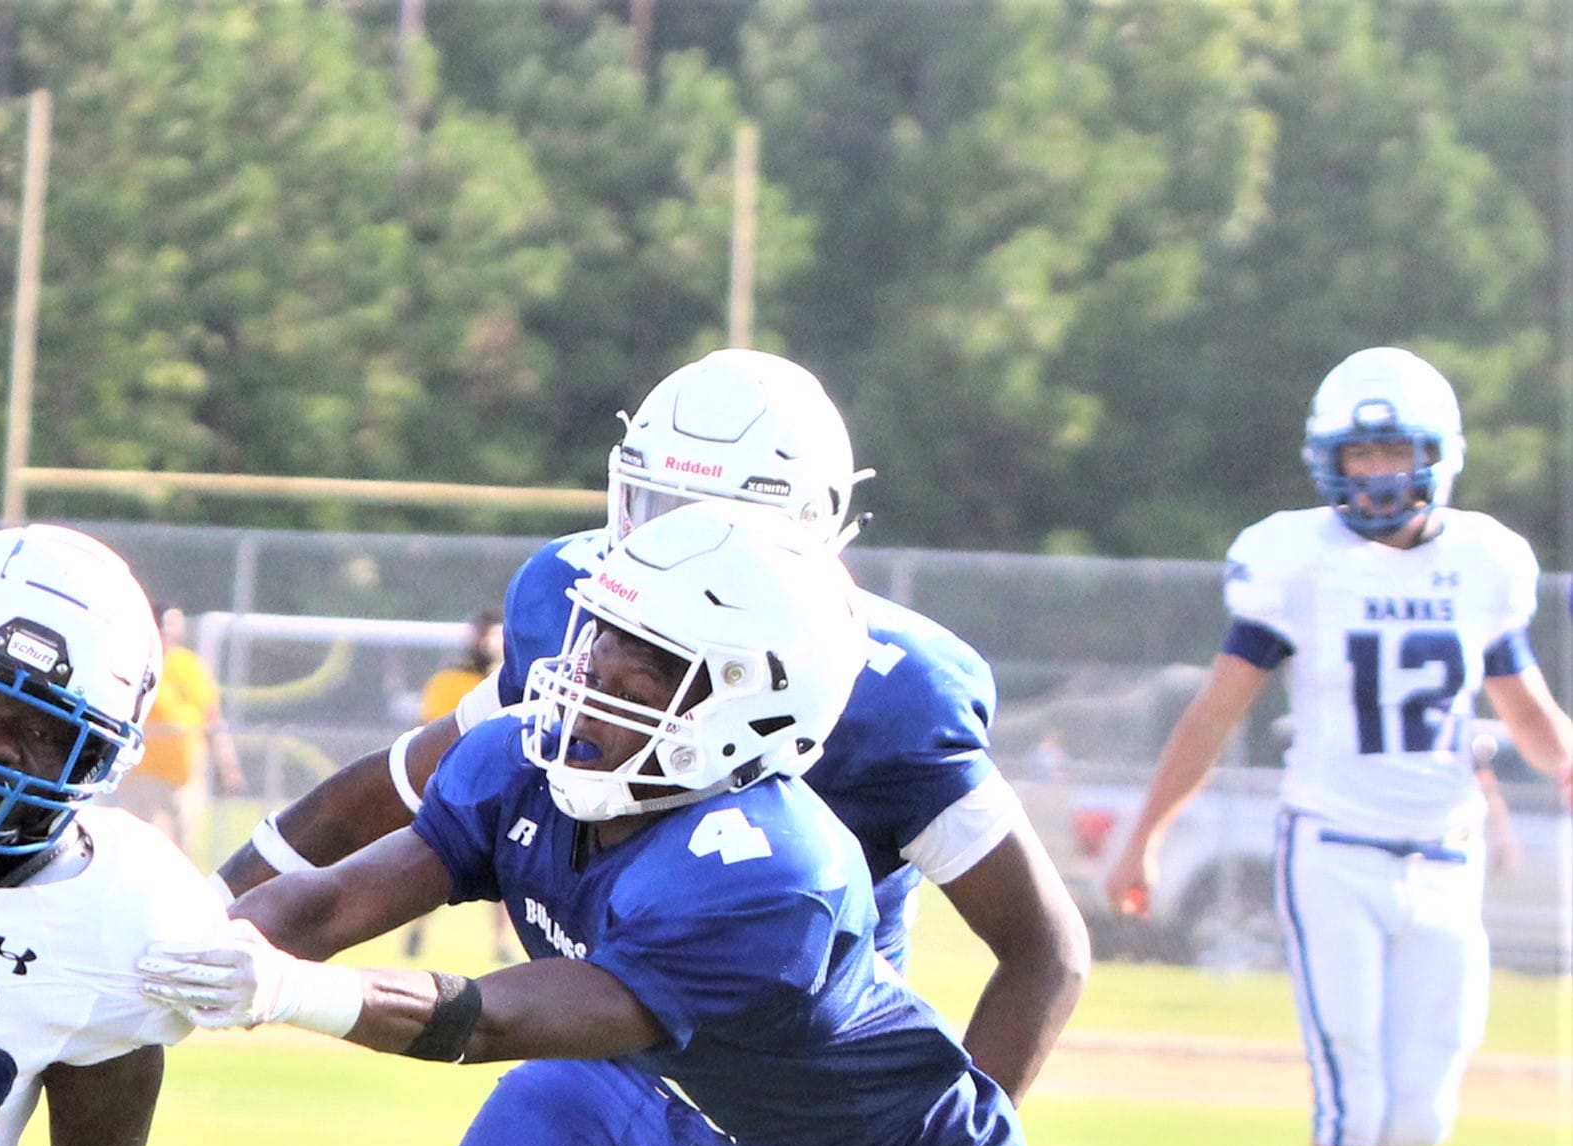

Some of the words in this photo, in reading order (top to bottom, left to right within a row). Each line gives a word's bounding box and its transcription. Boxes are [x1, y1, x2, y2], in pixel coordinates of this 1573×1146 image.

[665, 456, 723, 478] Riddell
[599, 572, 639, 603] Riddell
[10, 641, 54, 665] schutt
[570, 652, 588, 701] Riddll
[1345, 629, 1465, 754] 12
[687, 807, 773, 865] 4
